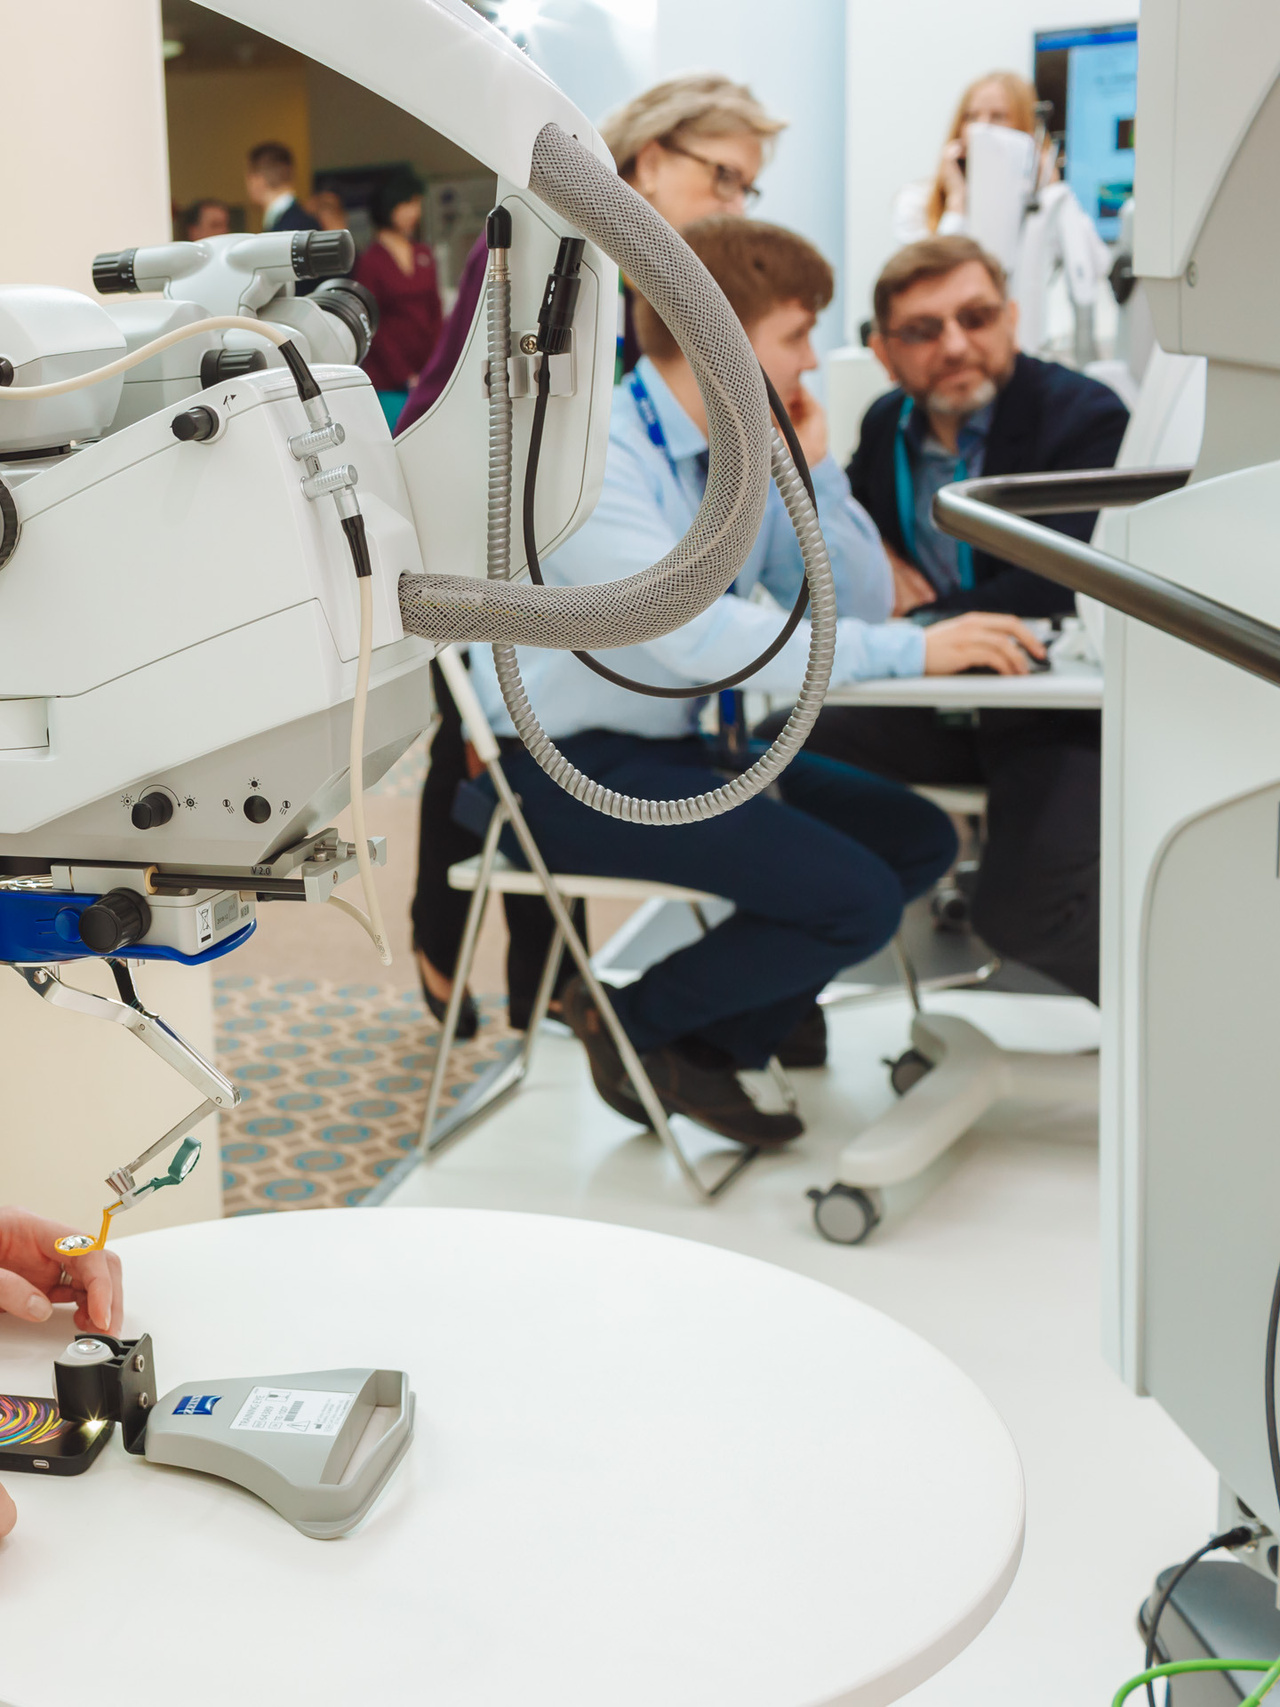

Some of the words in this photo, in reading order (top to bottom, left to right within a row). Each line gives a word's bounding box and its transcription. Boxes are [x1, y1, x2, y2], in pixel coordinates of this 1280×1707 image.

[251, 866, 257, 876] V
[259, 866, 271, 876] 2.0
[183, 1394, 201, 1416] ZEISS
